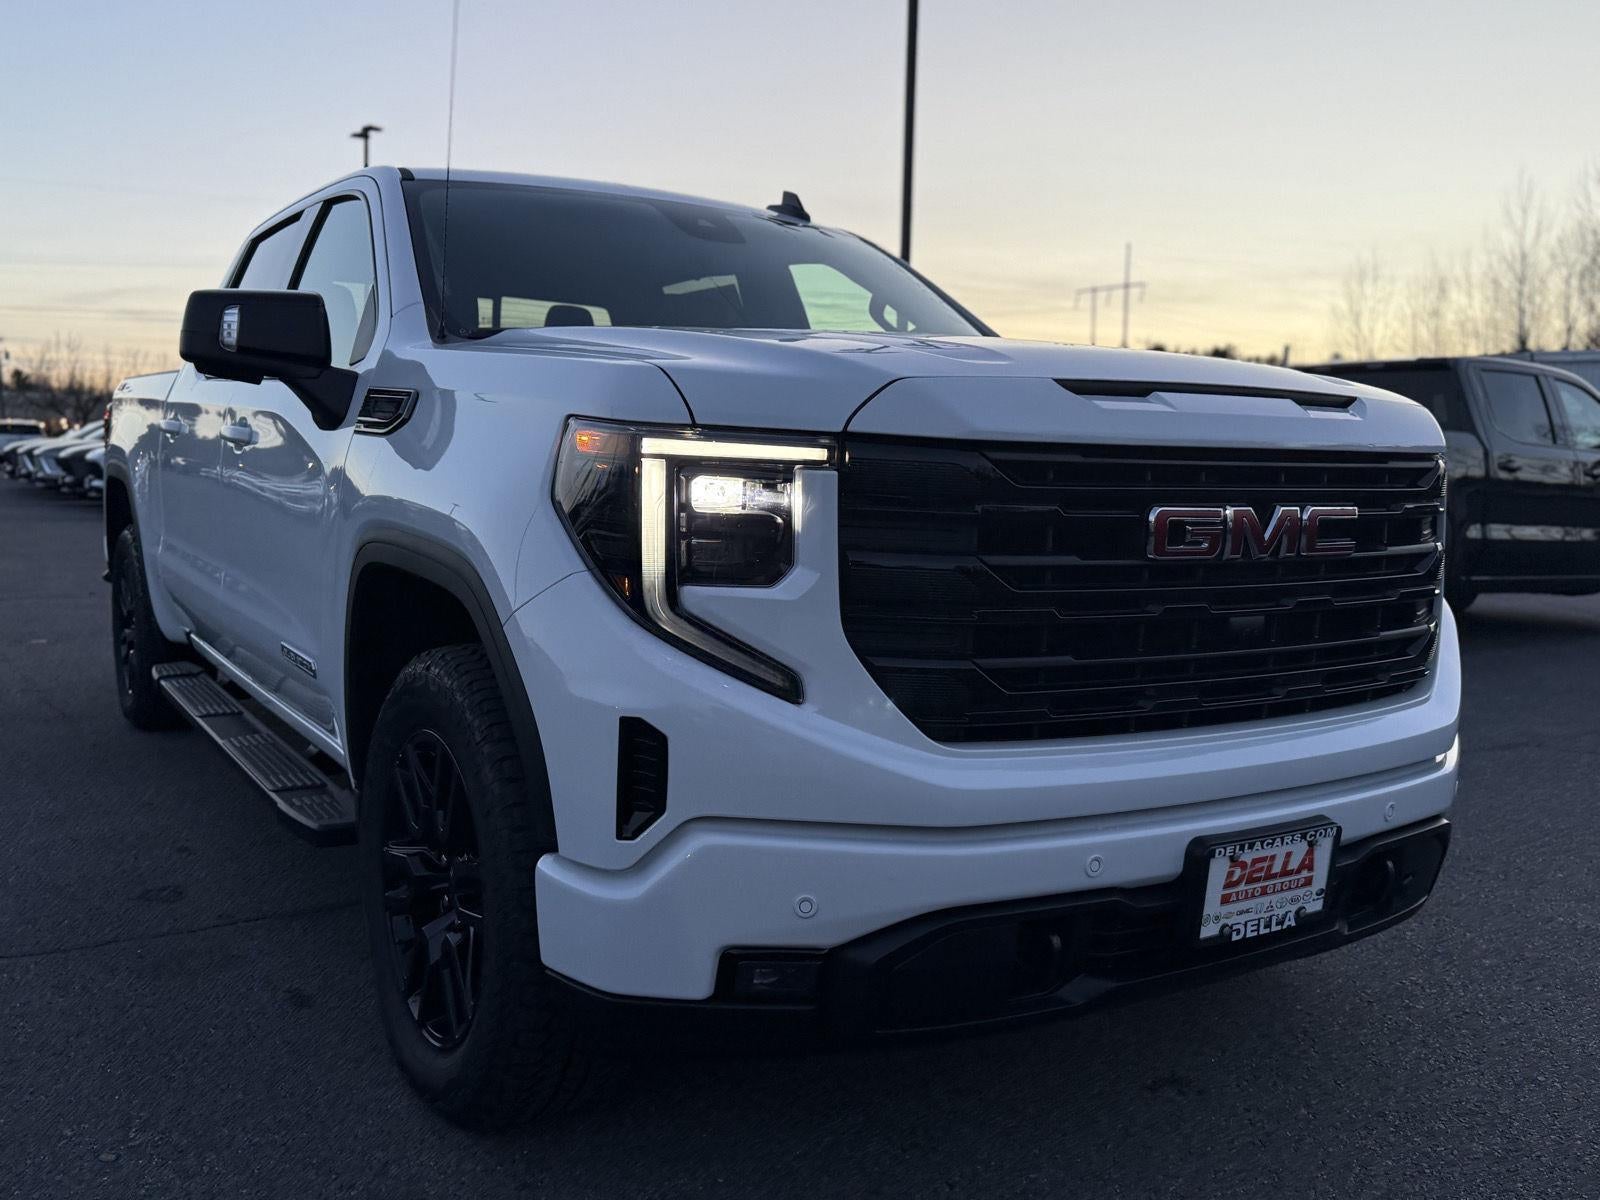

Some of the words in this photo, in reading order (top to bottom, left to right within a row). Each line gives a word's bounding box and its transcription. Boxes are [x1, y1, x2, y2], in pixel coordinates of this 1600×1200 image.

[1147, 505, 1359, 560] GMC
[1214, 826, 1336, 858] DELLACARS.COM
[1222, 847, 1315, 889] DELLA
[1229, 887, 1261, 902] AUTO
[1266, 878, 1305, 894] GROUP
[1231, 911, 1296, 942] DELLA
